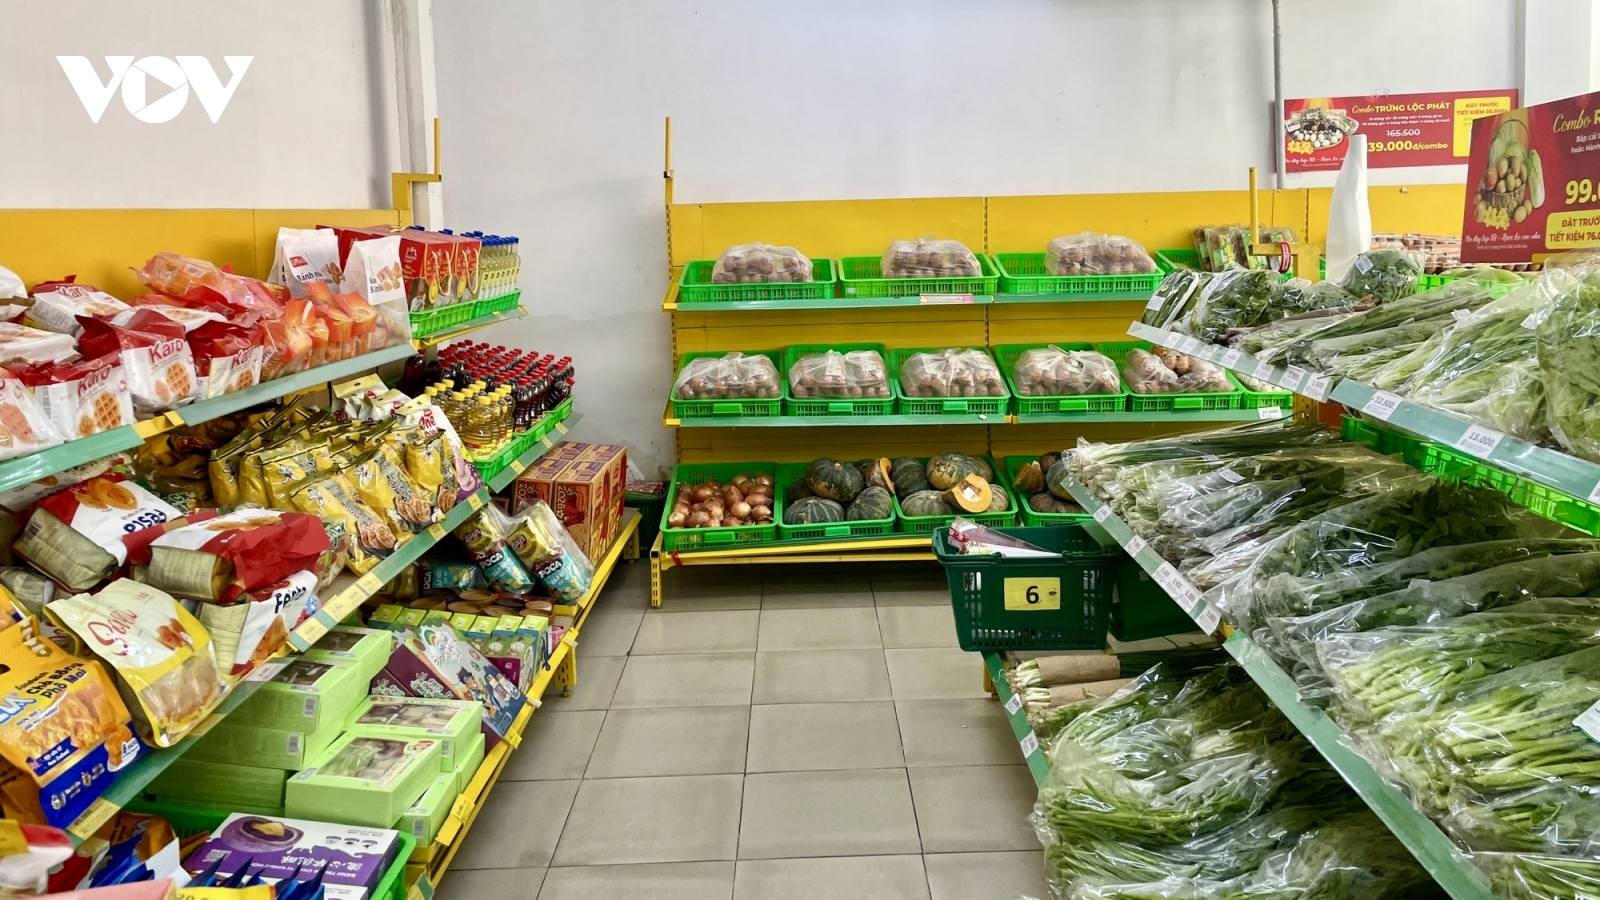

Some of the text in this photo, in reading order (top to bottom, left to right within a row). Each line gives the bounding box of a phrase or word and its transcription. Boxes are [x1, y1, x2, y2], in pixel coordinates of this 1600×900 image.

[1352, 101, 1450, 114] Combo TRỨNG LỘC PHÁT
[1553, 108, 1591, 134] Combo
[1386, 128, 1420, 137] 165.500
[1562, 216, 1577, 229] ĐẶT
[1550, 230, 1564, 242] TIẾT
[1566, 230, 1584, 244] KIỆM
[149, 339, 184, 364] Karo
[77, 364, 110, 397] Karo
[557, 486, 566, 510] 2026
[480, 552, 504, 570] POCA
[539, 560, 562, 579] POCA
[1026, 586, 1040, 604] 6
[40, 668, 88, 698] Phô Mai
